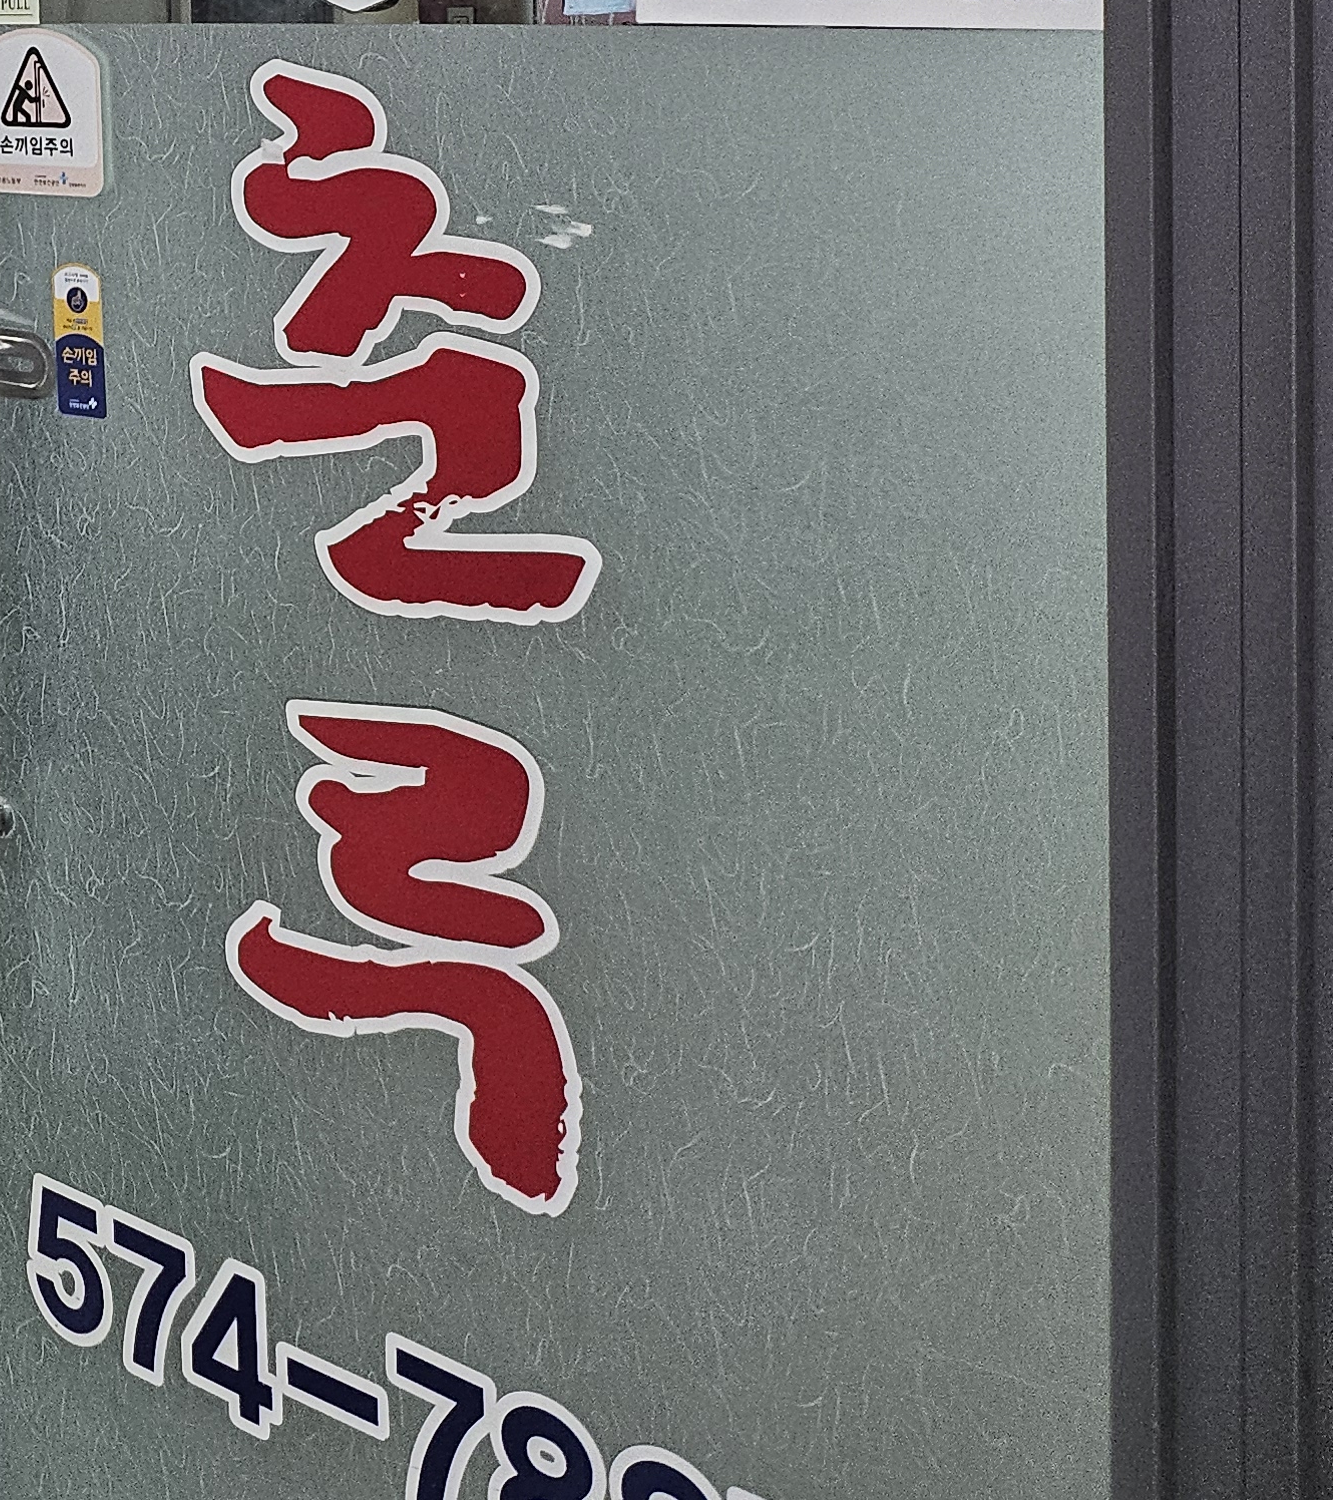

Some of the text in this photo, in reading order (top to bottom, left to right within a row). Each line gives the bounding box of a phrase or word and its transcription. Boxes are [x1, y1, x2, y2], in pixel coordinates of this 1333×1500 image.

[0, 135, 74, 157] 손끼임주의
[61, 346, 98, 366] 손끼임
[68, 368, 93, 388] 주의
